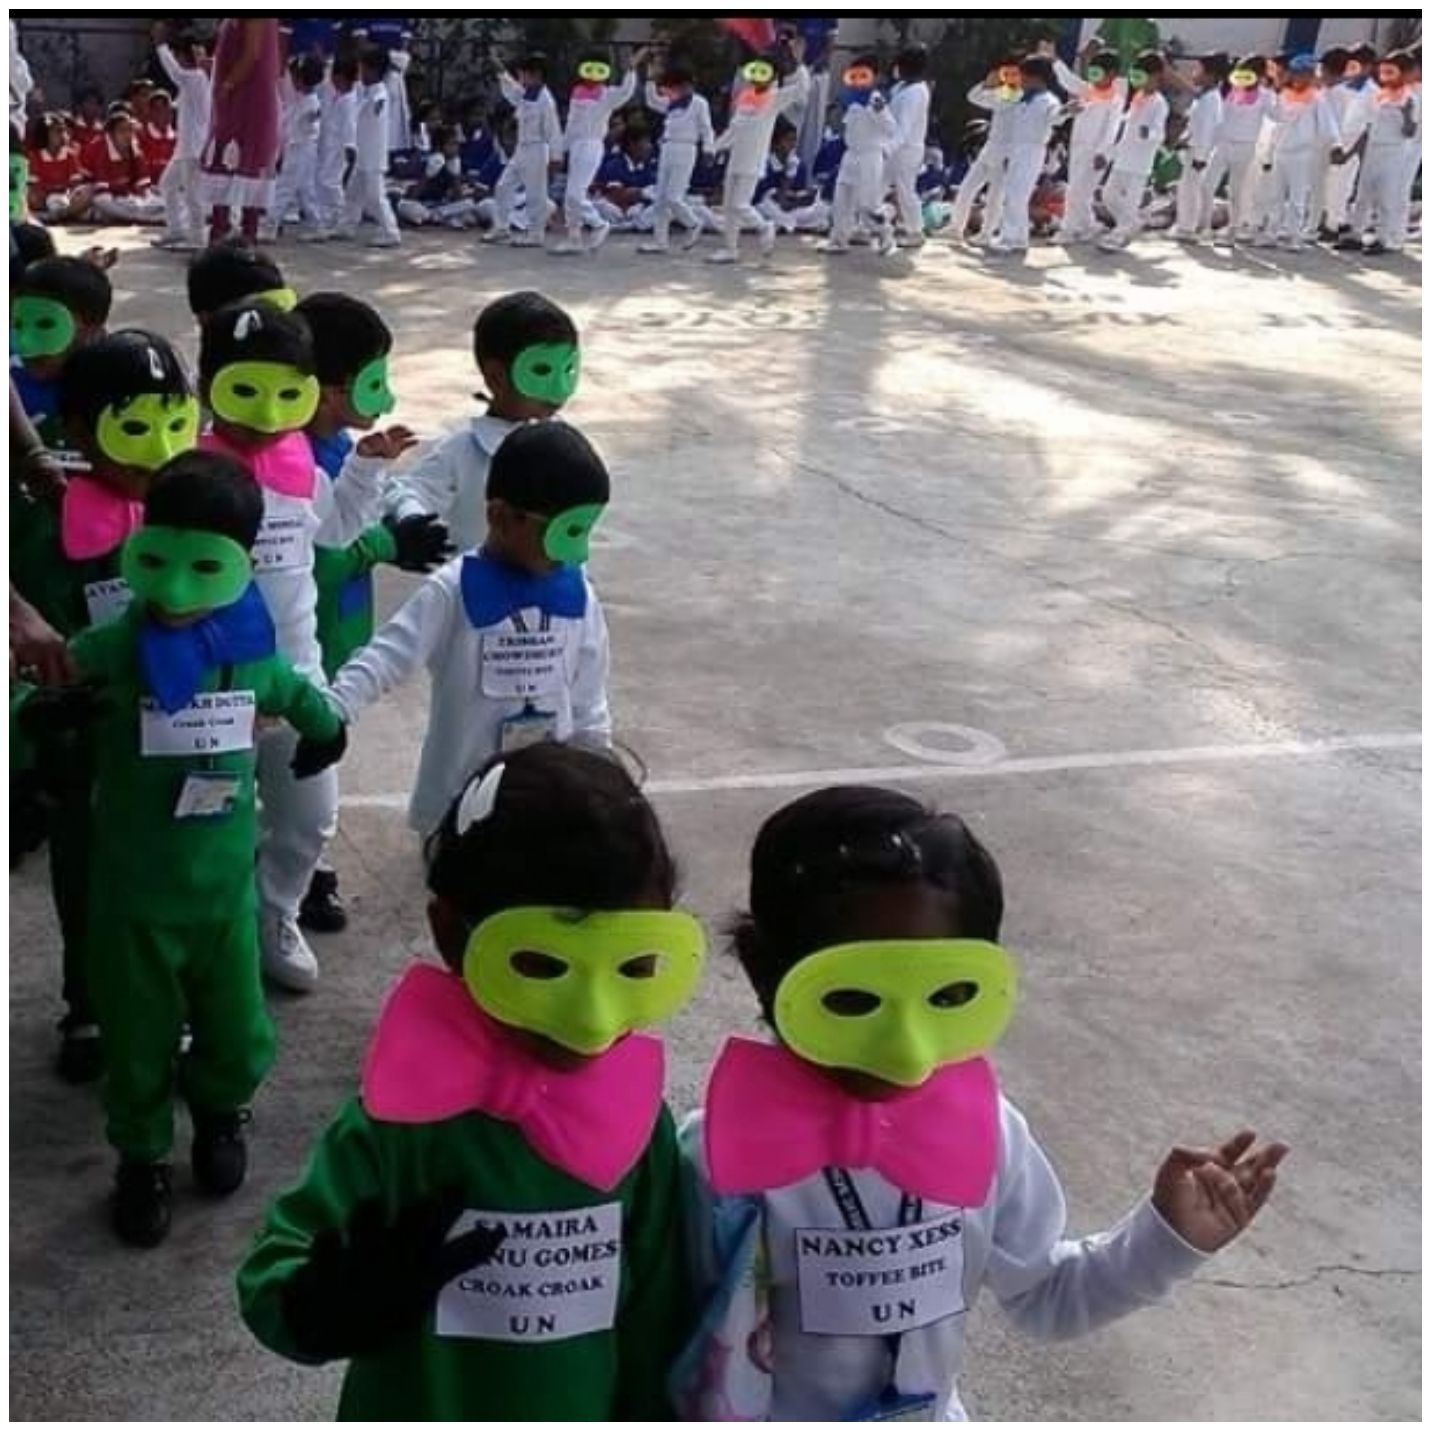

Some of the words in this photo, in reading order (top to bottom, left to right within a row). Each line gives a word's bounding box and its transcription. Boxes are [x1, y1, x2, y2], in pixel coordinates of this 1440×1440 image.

[194, 737, 207, 750] U
[209, 735, 219, 749] N
[474, 1215, 599, 1241] SAMAIRA
[801, 1235, 901, 1257] NANCY
[908, 1218, 962, 1250] XESS
[533, 1239, 617, 1268] GOMES
[825, 1269, 905, 1287] TOFFEE
[910, 1257, 946, 1280] BITE
[460, 1278, 531, 1298] CROAK
[537, 1275, 604, 1297] CROAK
[871, 1304, 892, 1323] U
[898, 1298, 916, 1320] N
[511, 1315, 529, 1334] U
[537, 1313, 555, 1335] N
